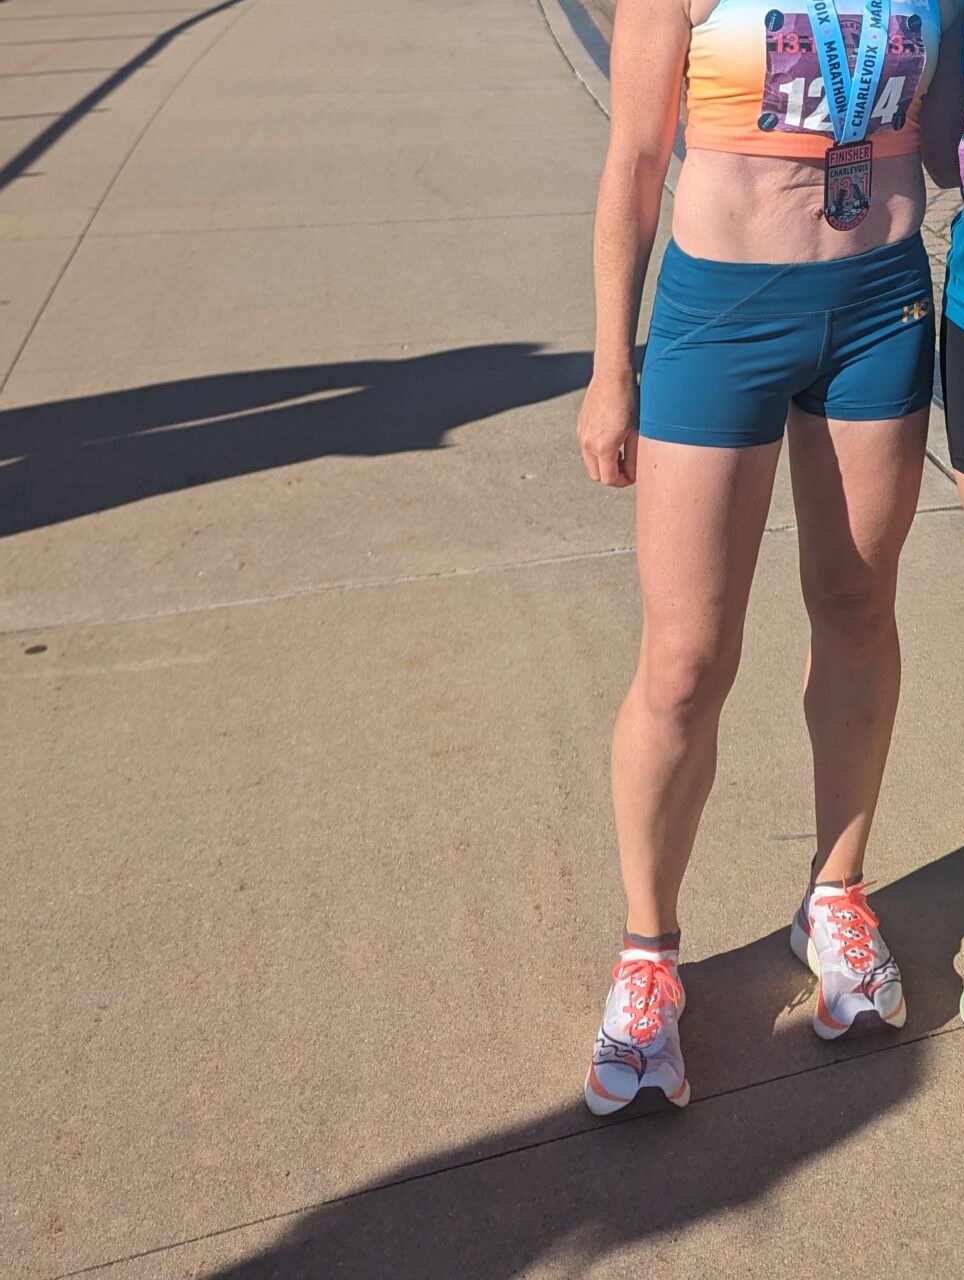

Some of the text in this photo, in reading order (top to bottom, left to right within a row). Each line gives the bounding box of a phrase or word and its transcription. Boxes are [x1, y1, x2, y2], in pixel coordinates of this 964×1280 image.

[773, 31, 818, 55] 13.1
[885, 34, 922, 55] 3.1
[824, 39, 848, 115] MARATHON
[851, 43, 878, 128] CHARLEVOIX
[778, 76, 906, 132] 124
[830, 148, 871, 166] FINISHER
[829, 163, 870, 178] CHARLEVOIX
